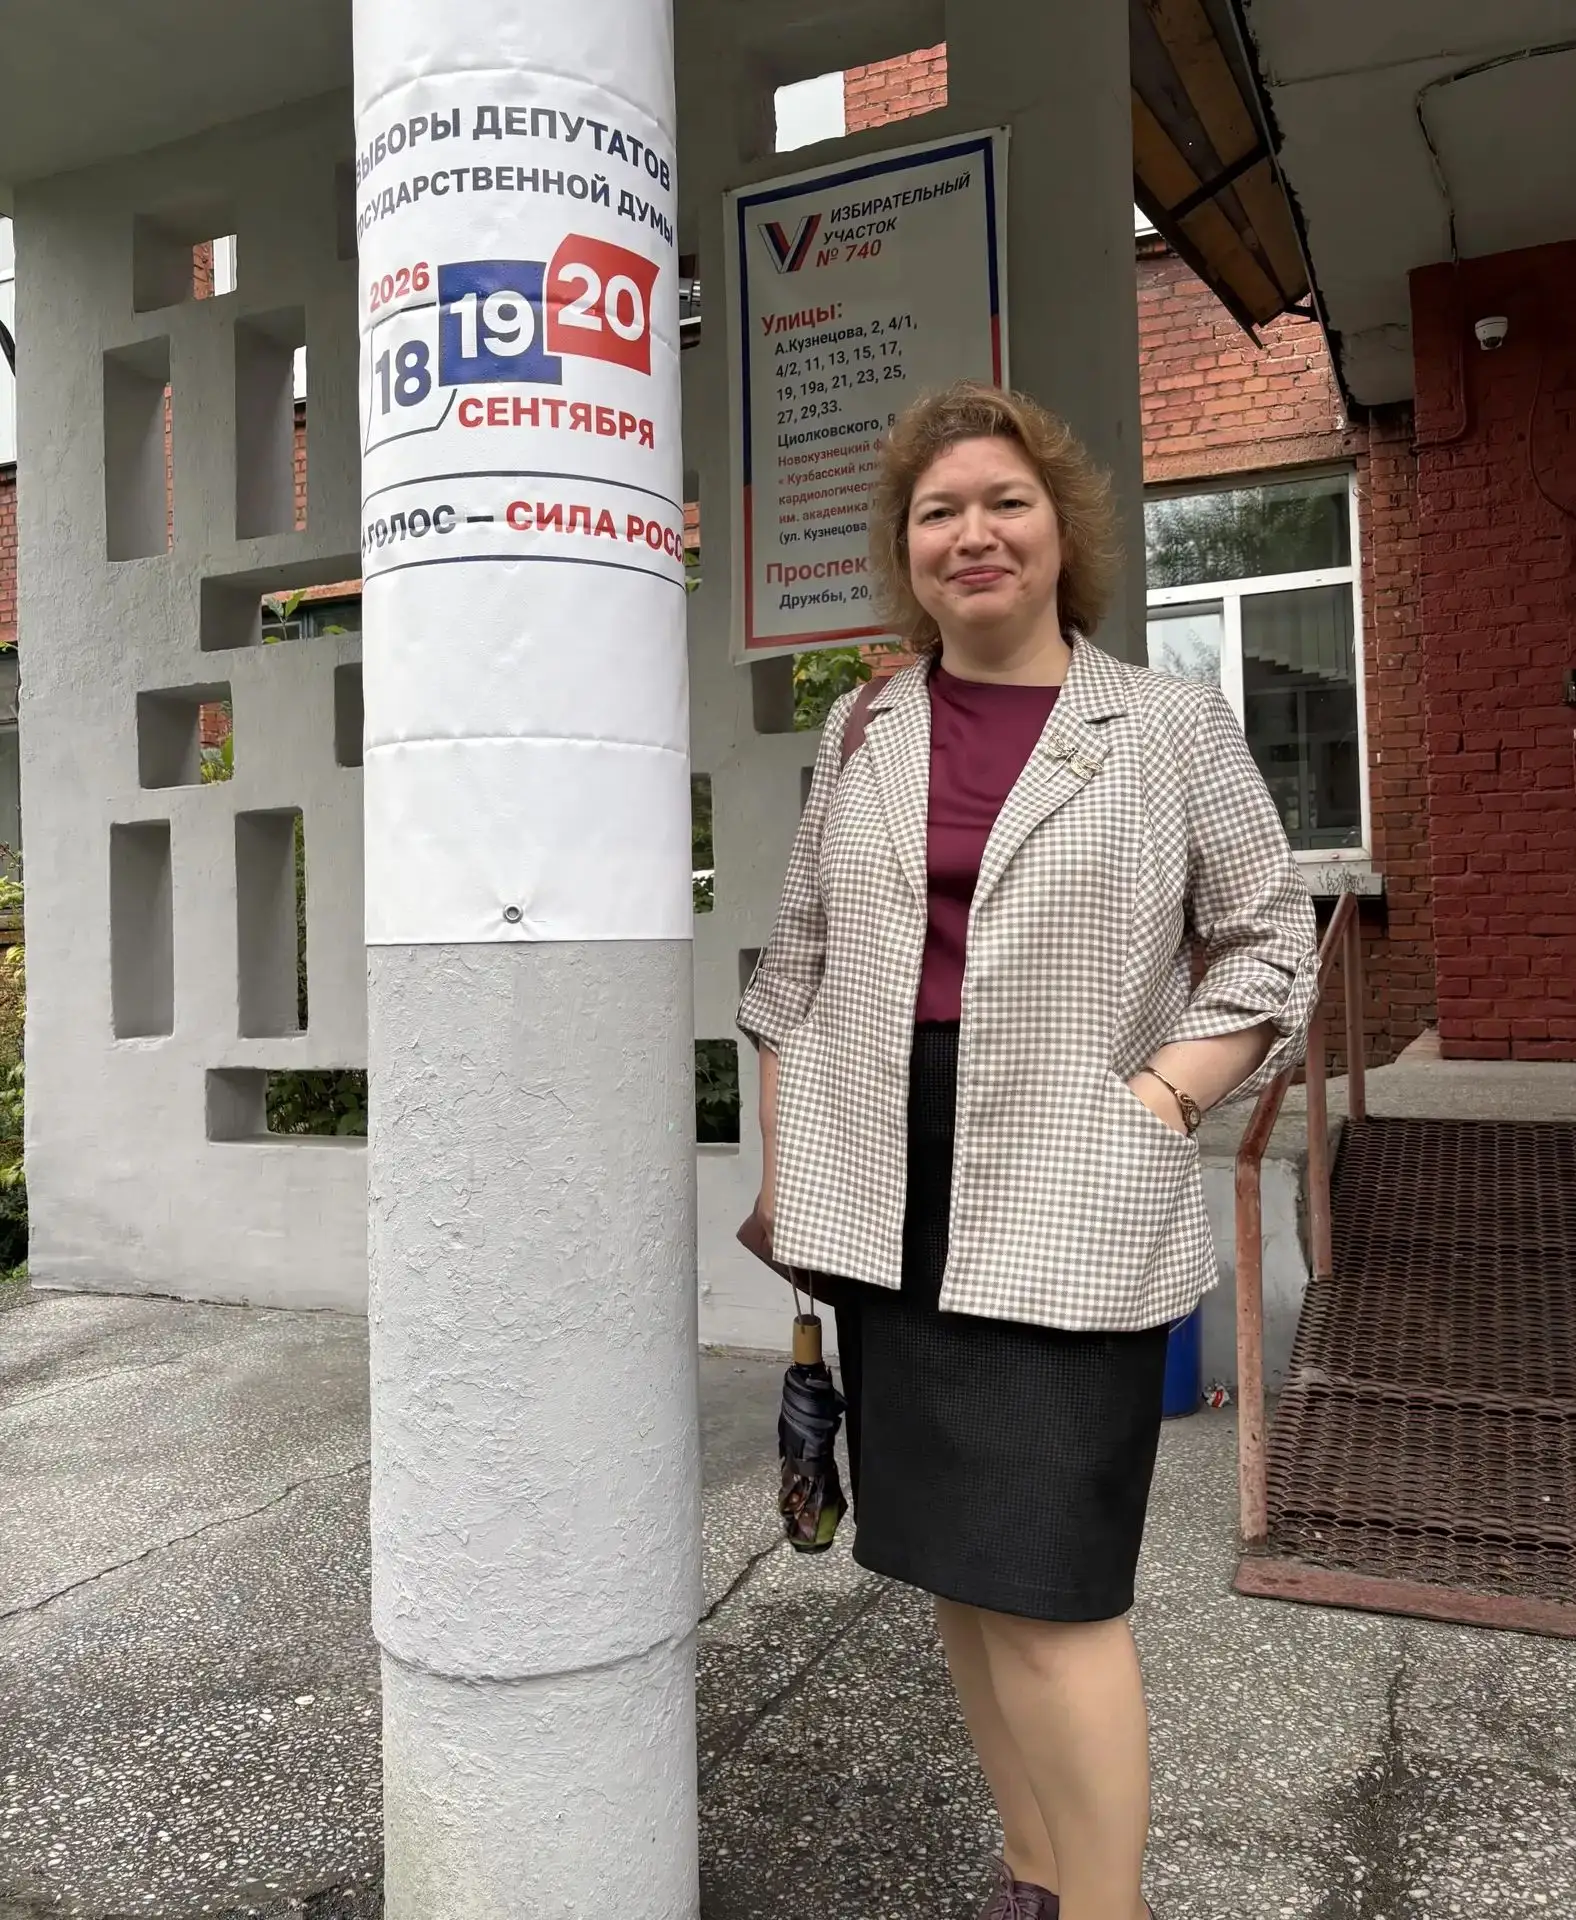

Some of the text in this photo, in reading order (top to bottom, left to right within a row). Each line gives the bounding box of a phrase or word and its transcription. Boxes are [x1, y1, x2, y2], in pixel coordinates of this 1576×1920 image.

[356, 105, 670, 193] ВЫБОРЫ ДЕПУТАТОВ
[357, 165, 673, 248] ОСУДАРСТВЕННОЙ ДУМЫ
[831, 170, 971, 224] ИЗБИРАТЕЛЬНЫЙ
[823, 216, 899, 246] УЧАСТОК
[845, 238, 882, 262] 740
[369, 261, 430, 314] 2026
[557, 262, 645, 342] 20
[450, 289, 535, 358] 19
[761, 302, 843, 337] Улицы:
[774, 314, 918, 356] А.Кузнецова, 2, 4/1,
[375, 339, 432, 416] 18
[775, 339, 903, 379] 4/2, 11, 13, 15, 17,
[776, 386, 797, 402] 19,
[831, 373, 853, 390] 21,
[856, 369, 879, 385] 23,
[883, 363, 907, 381] 25,
[458, 396, 655, 450] СЕНТЯБРЯ
[777, 409, 798, 425] 27,
[777, 417, 884, 449] Циолковского,
[777, 440, 871, 468] Новокузнецкий
[787, 462, 856, 487] Кузбасский
[367, 504, 456, 555] ГОЛОС
[505, 500, 618, 540] СИЛА
[626, 513, 684, 564] РОСС
[778, 513, 800, 525] им.
[802, 501, 868, 522] академика
[778, 531, 801, 546] (ул.
[765, 556, 869, 588] Проспек
[778, 588, 847, 610] Дружбы,
[850, 585, 873, 601] 20,
